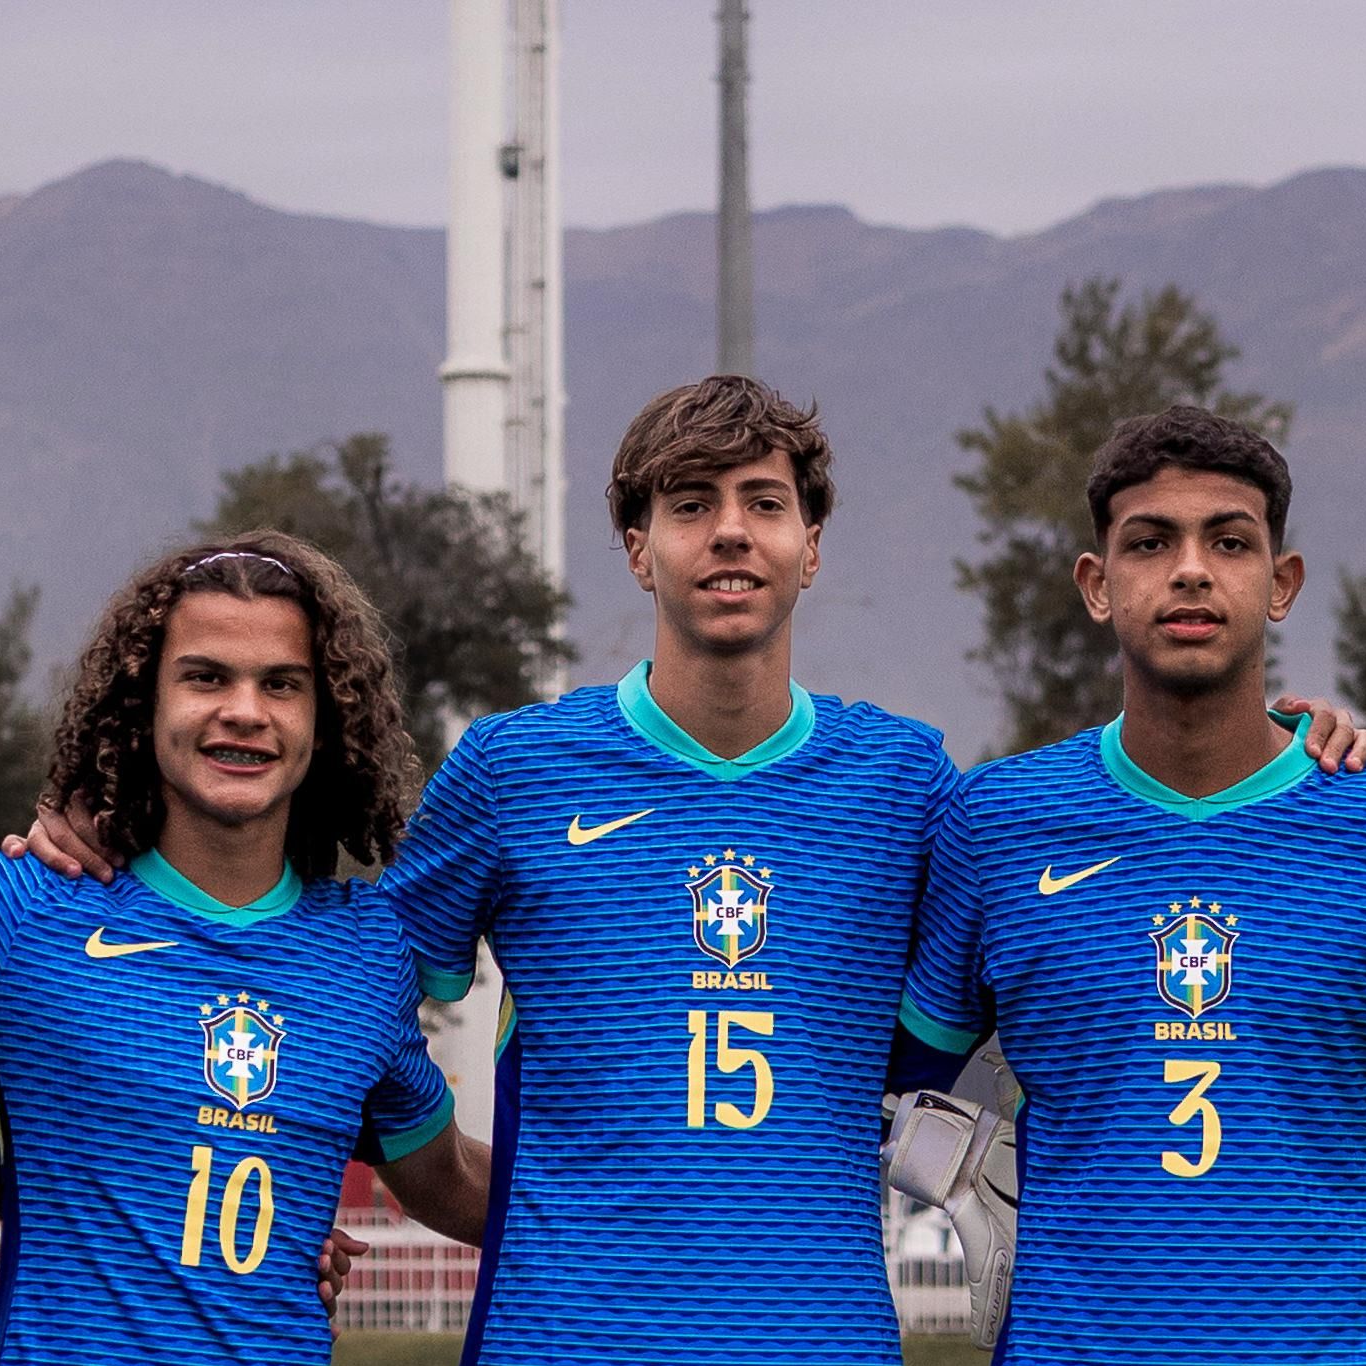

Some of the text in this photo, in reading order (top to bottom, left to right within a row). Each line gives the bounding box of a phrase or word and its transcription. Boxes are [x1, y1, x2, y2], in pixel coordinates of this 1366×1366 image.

[716, 906, 744, 918] CBF
[1180, 956, 1209, 968] CBF
[692, 971, 773, 990] BRASIL
[1154, 1022, 1237, 1040] BRASIL
[227, 1048, 255, 1061] CBF
[687, 1010, 774, 1128] 15
[197, 1105, 278, 1134] BRASIL
[1161, 1059, 1222, 1177] 3
[180, 1145, 274, 1274] 10
